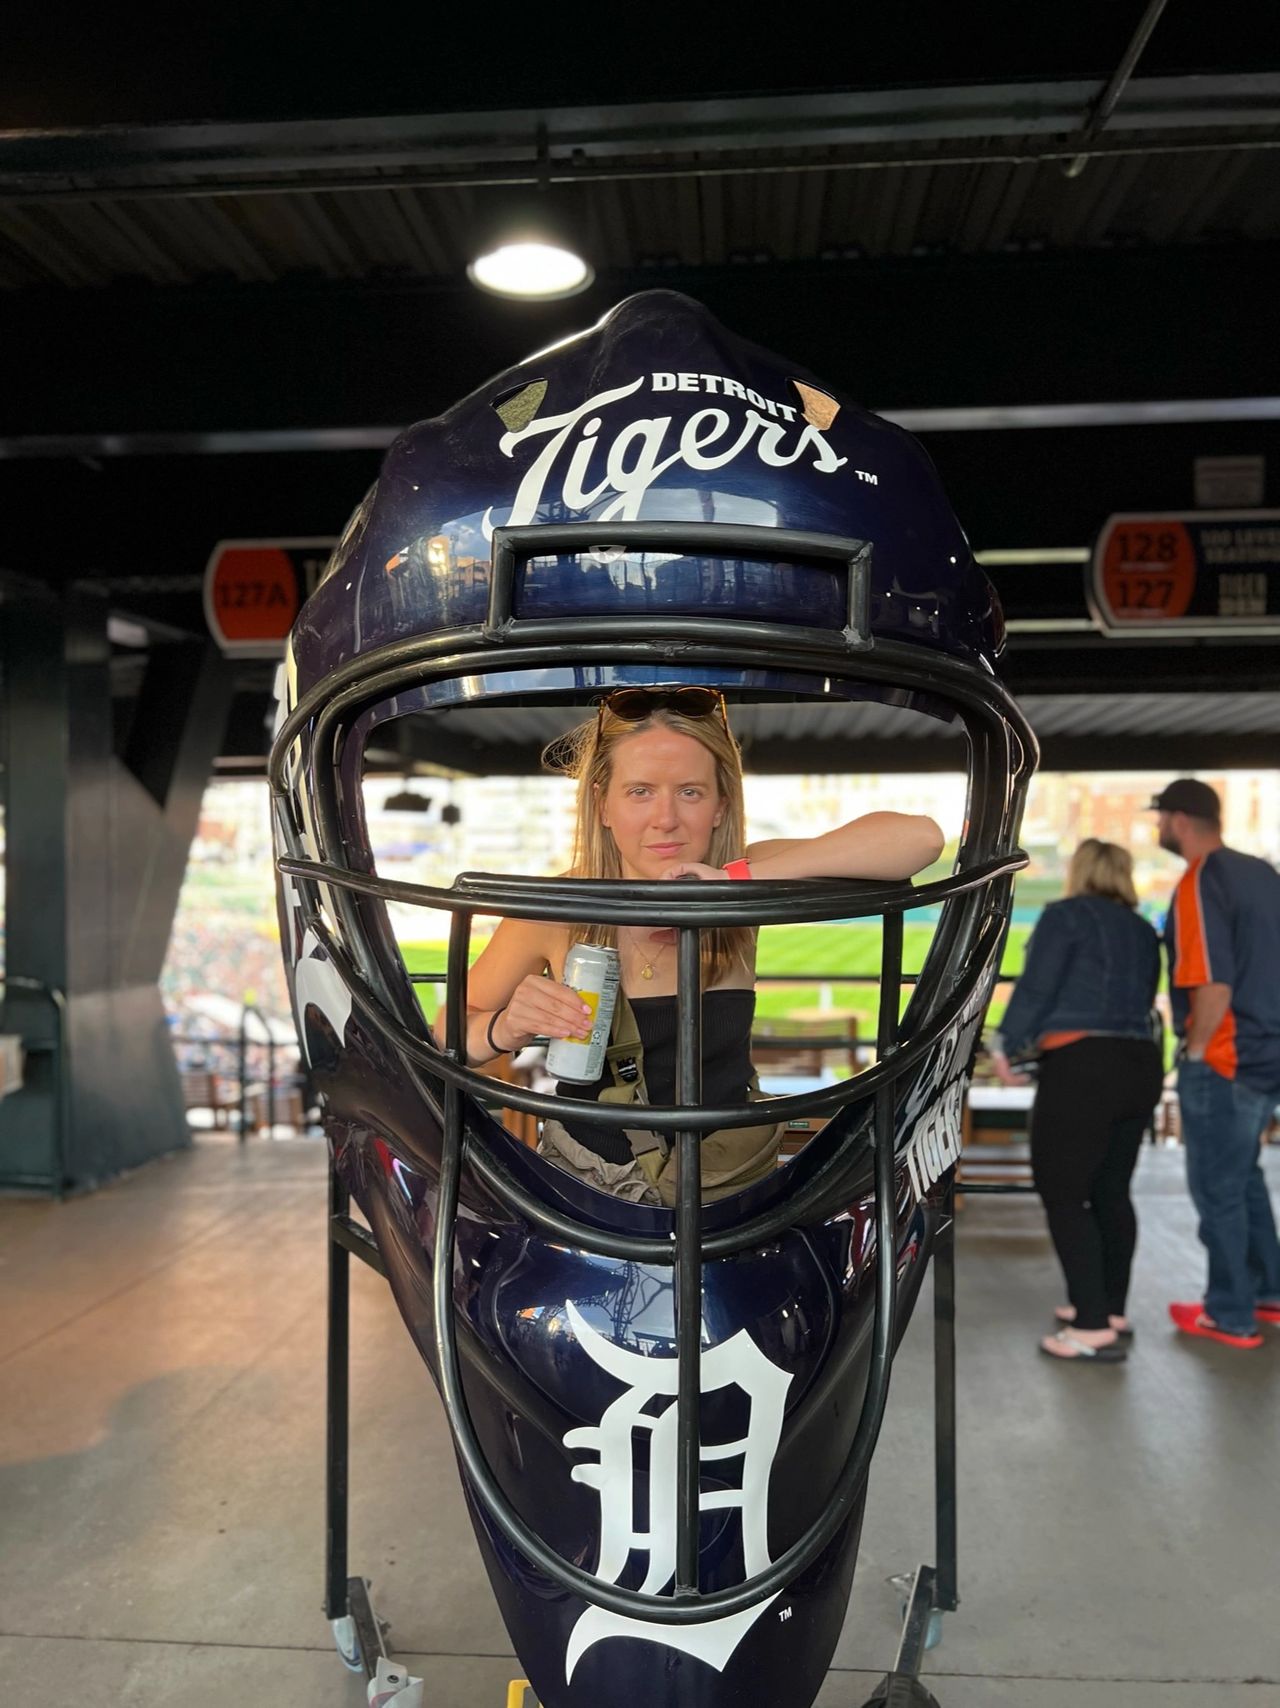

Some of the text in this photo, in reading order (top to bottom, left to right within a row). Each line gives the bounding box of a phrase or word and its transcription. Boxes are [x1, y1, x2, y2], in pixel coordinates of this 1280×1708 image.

[651, 371, 798, 423] DETROIT
[481, 375, 849, 542] Tigers
[854, 470, 879, 486] TM
[1118, 531, 1178, 561] 128
[1118, 579, 1175, 609] 127
[562, 1298, 795, 1686] D
[778, 1605, 793, 1623] TM
